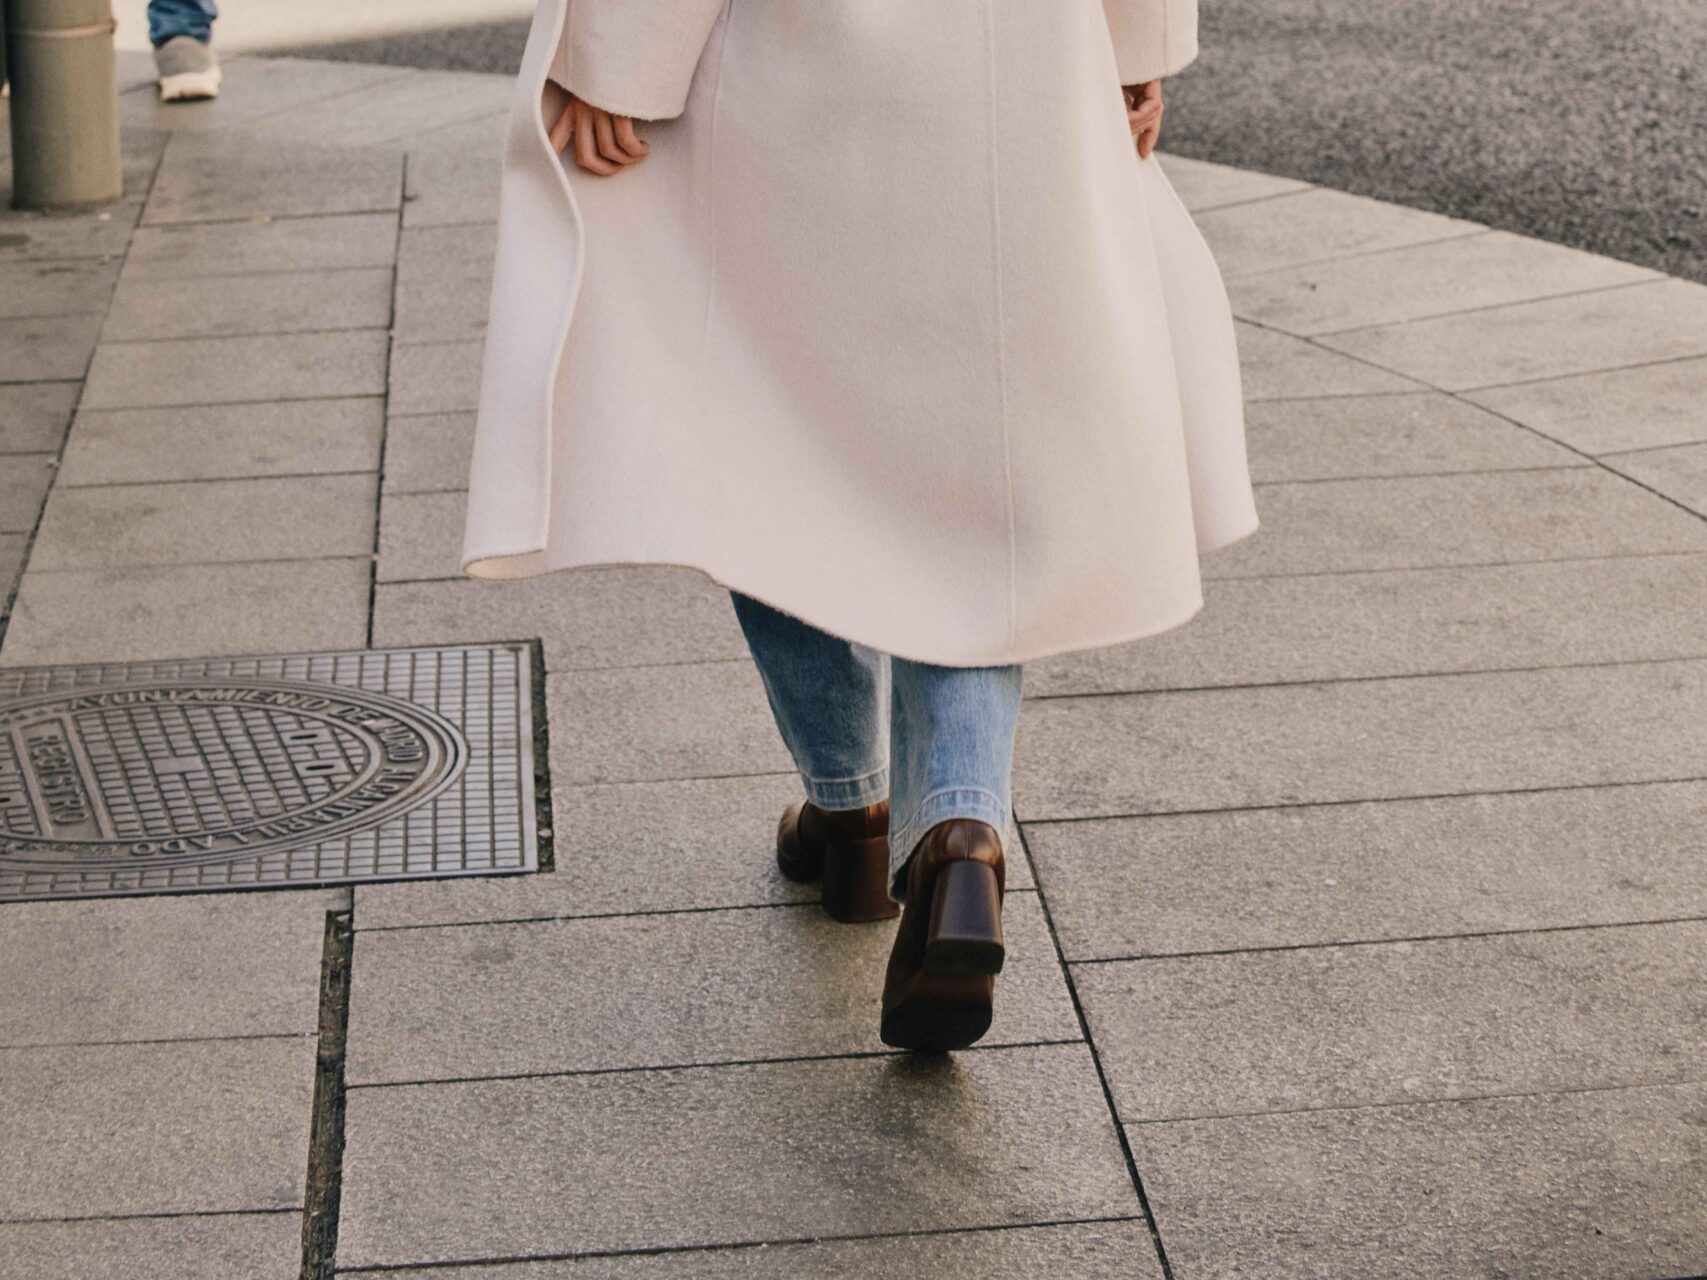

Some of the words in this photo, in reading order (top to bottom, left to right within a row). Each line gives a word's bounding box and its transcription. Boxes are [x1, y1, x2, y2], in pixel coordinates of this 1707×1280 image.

[71, 689, 331, 710] AYUNTAMIENTO
[327, 706, 381, 724] DE
[362, 719, 423, 762] MADRID
[28, 734, 89, 825] REGISTRO
[130, 768, 416, 856] ALCANTARILLADO
